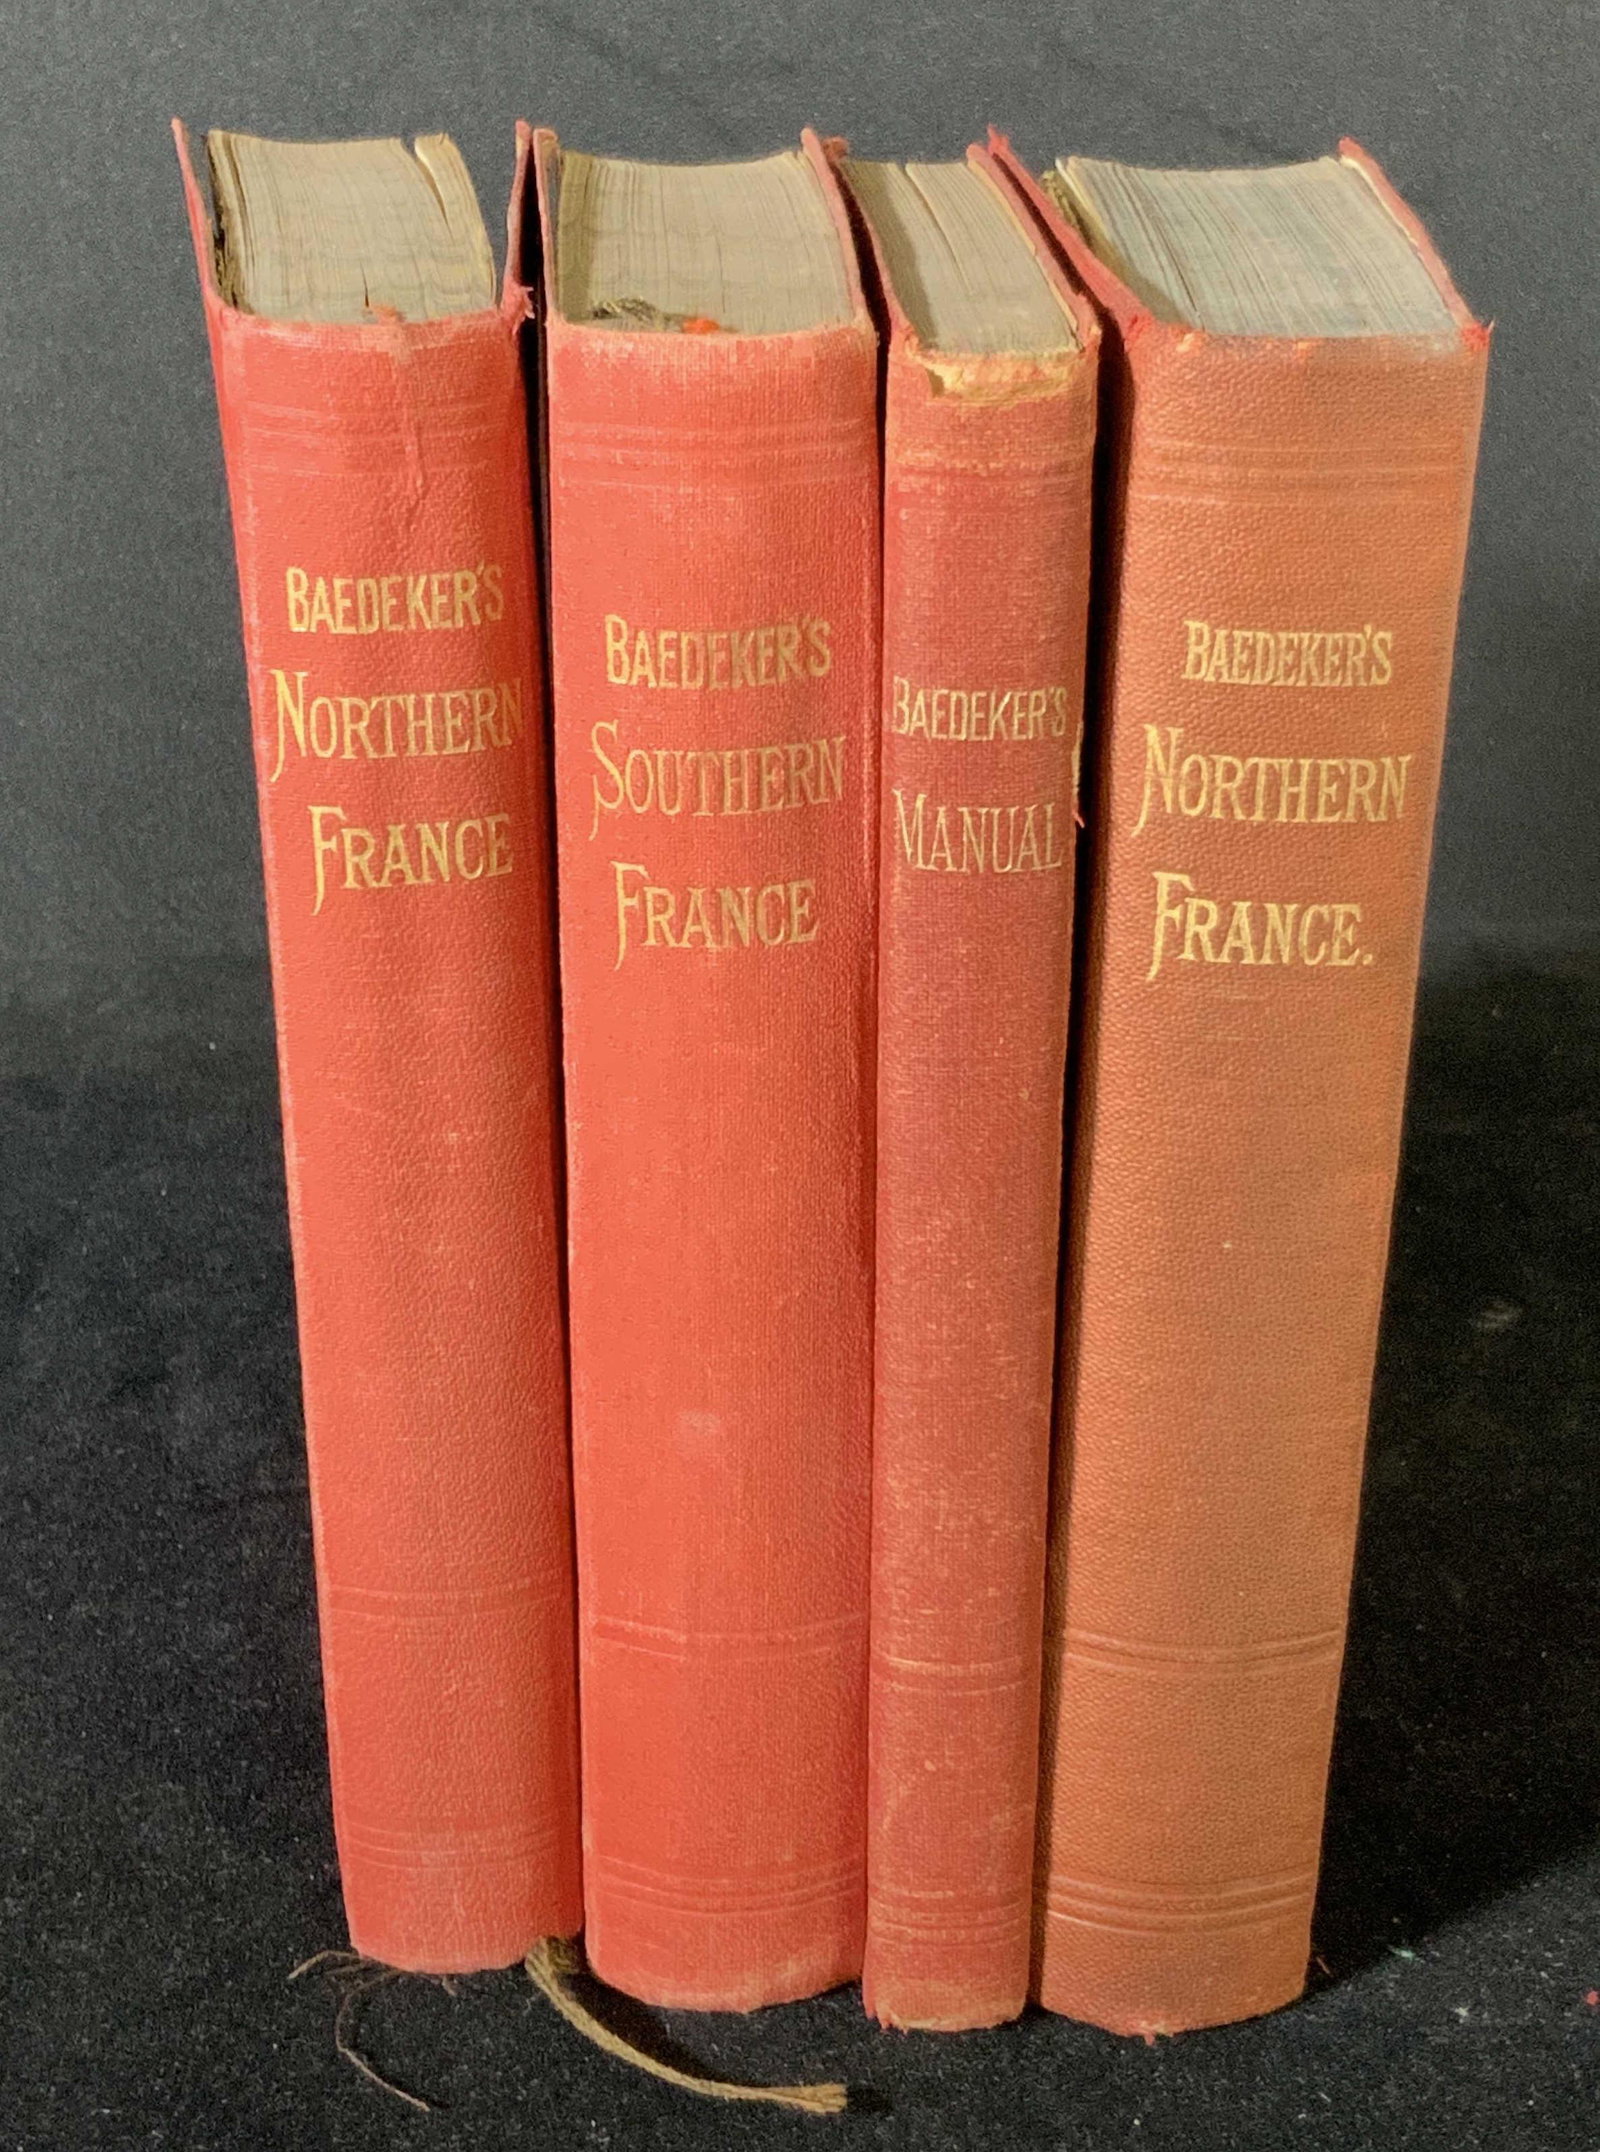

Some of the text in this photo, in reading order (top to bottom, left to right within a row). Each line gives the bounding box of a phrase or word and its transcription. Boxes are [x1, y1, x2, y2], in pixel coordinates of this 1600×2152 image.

[285, 559, 505, 635] BAEDEKER'S
[604, 614, 832, 690] BAEDEKER'S
[892, 675, 1067, 741] BAEDEKER'S
[1181, 620, 1393, 687] BAEDEKER'S
[269, 669, 522, 783] NORTHERN
[588, 719, 847, 842] SOUTHERN
[1131, 724, 1412, 838] NORTHERN
[307, 805, 513, 915] FRANCE
[892, 788, 1063, 874] MANUAL
[610, 860, 818, 971] FRANCE
[1146, 871, 1373, 982] FRANCE.
